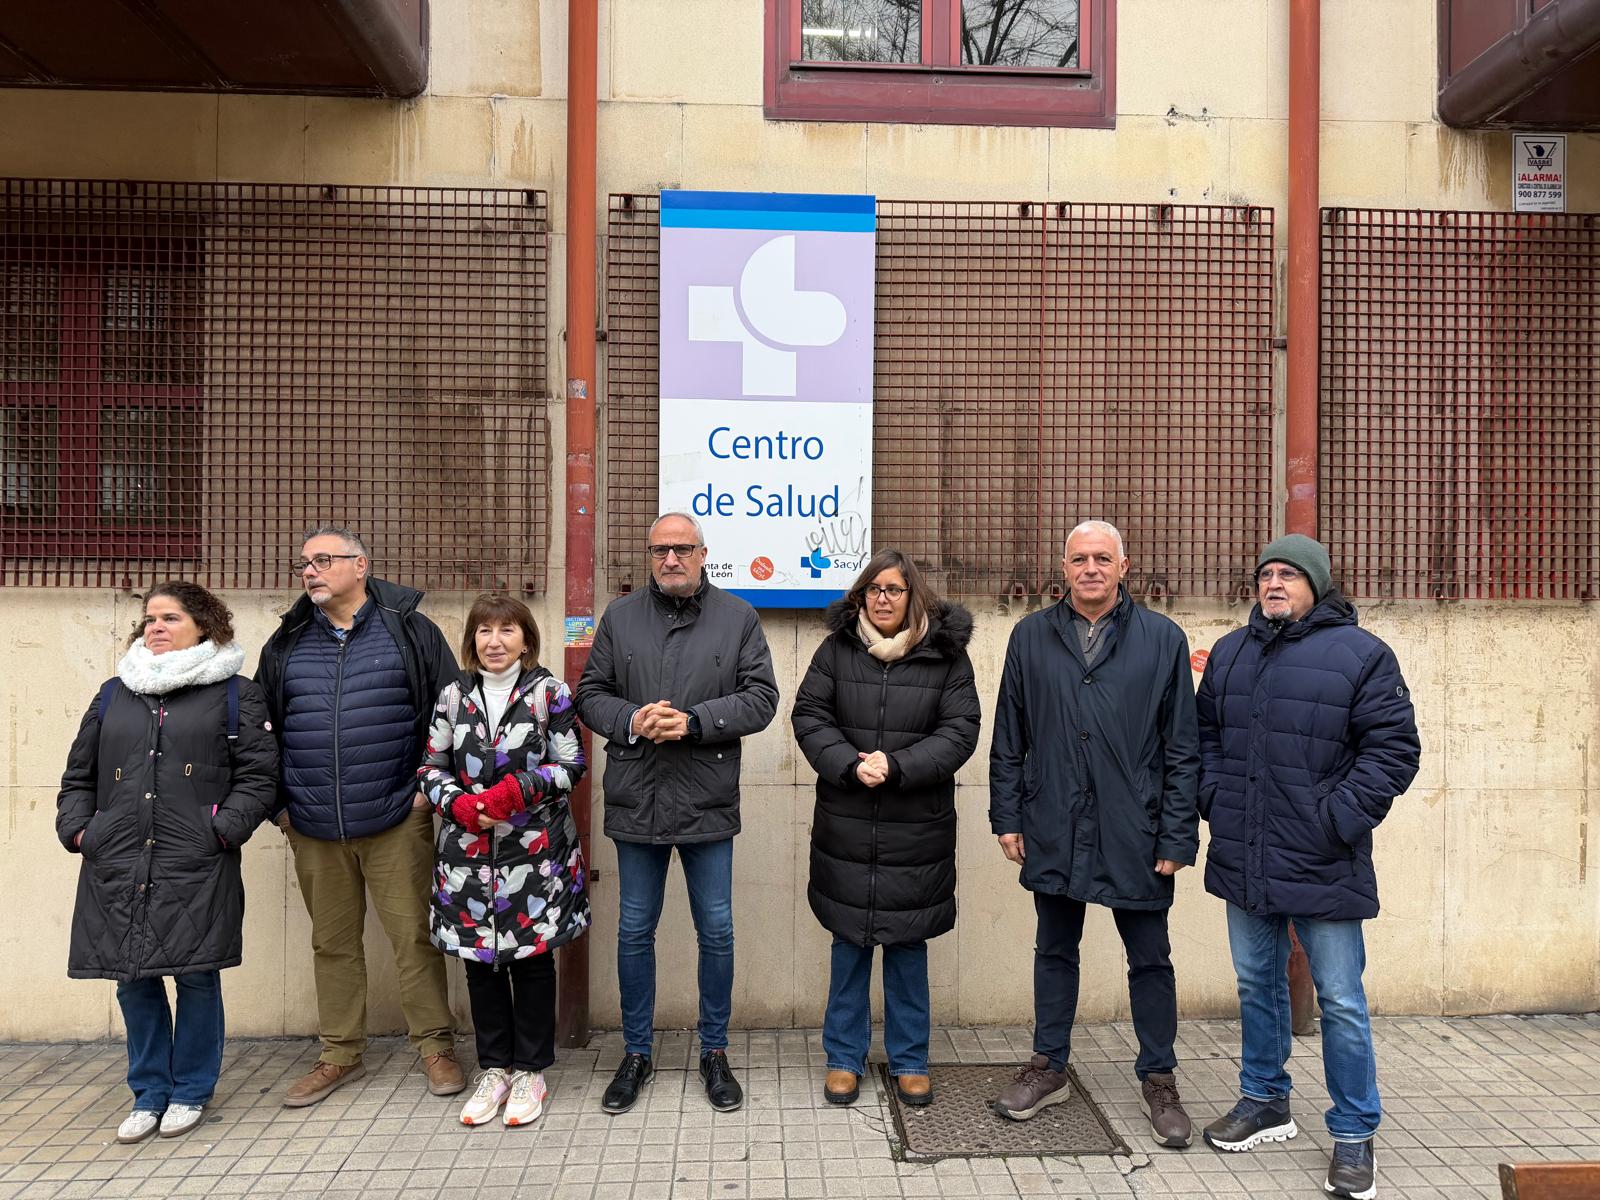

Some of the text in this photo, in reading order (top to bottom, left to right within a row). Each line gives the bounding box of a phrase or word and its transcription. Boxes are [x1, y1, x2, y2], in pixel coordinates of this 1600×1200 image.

[1518, 173, 1562, 182] ¡ALARMA!
[1518, 190, 1532, 198] 900
[1533, 190, 1547, 198] 877
[708, 427, 824, 460] Centro
[692, 483, 839, 518] de Salud
[721, 562, 733, 570] de
[834, 559, 862, 571] Sacyl
